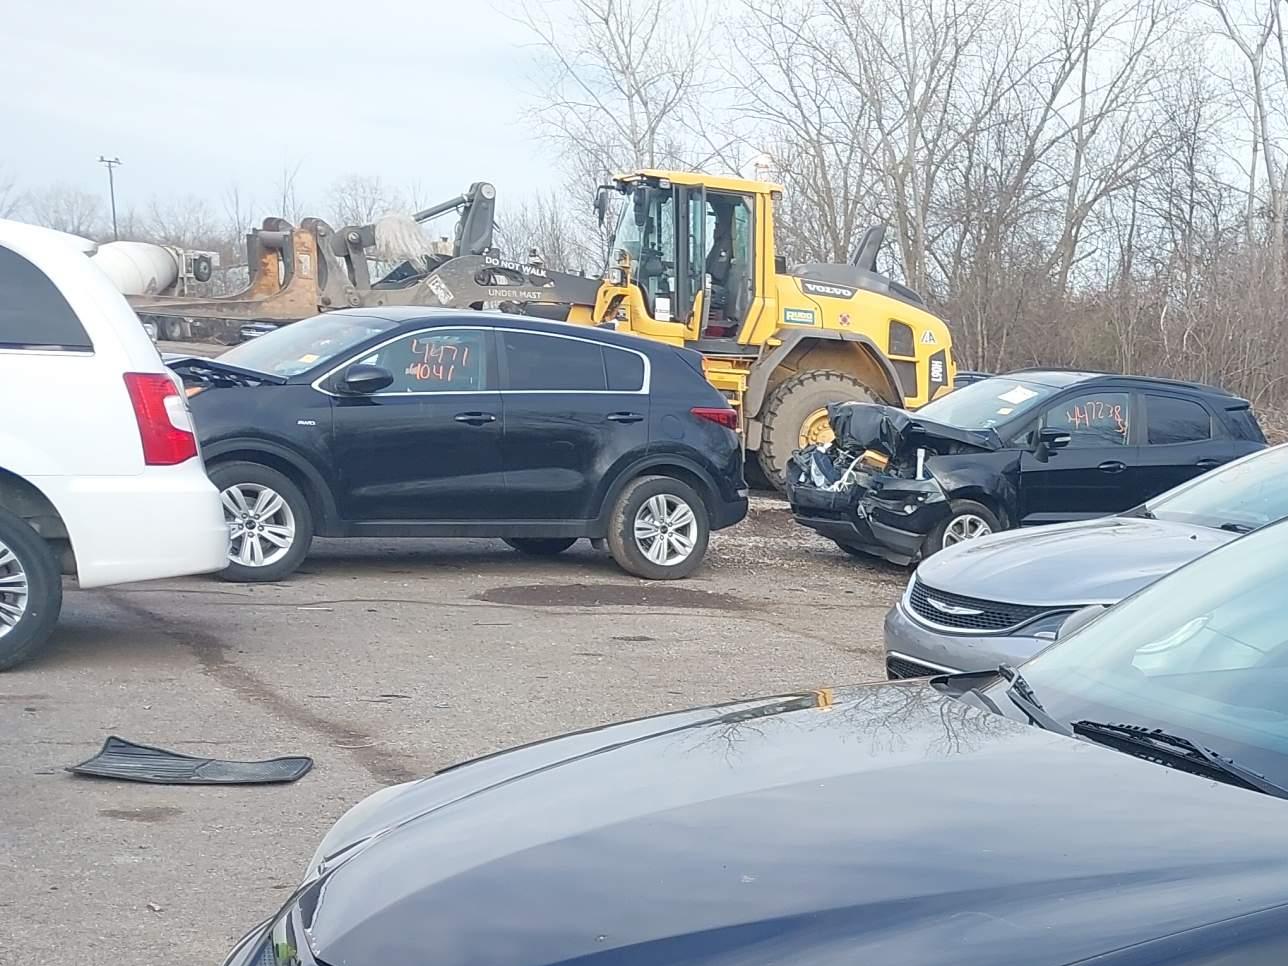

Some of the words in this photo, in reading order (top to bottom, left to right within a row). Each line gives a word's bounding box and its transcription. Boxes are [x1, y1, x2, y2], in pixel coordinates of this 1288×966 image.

[485, 256, 499, 266] DO
[500, 260, 519, 271] NOT
[521, 265, 547, 278] WALK
[488, 289, 518, 298] UNDER
[520, 291, 542, 299] MAST
[804, 283, 853, 297] VOLVO
[410, 338, 469, 367] 4471
[930, 360, 943, 382] L90H
